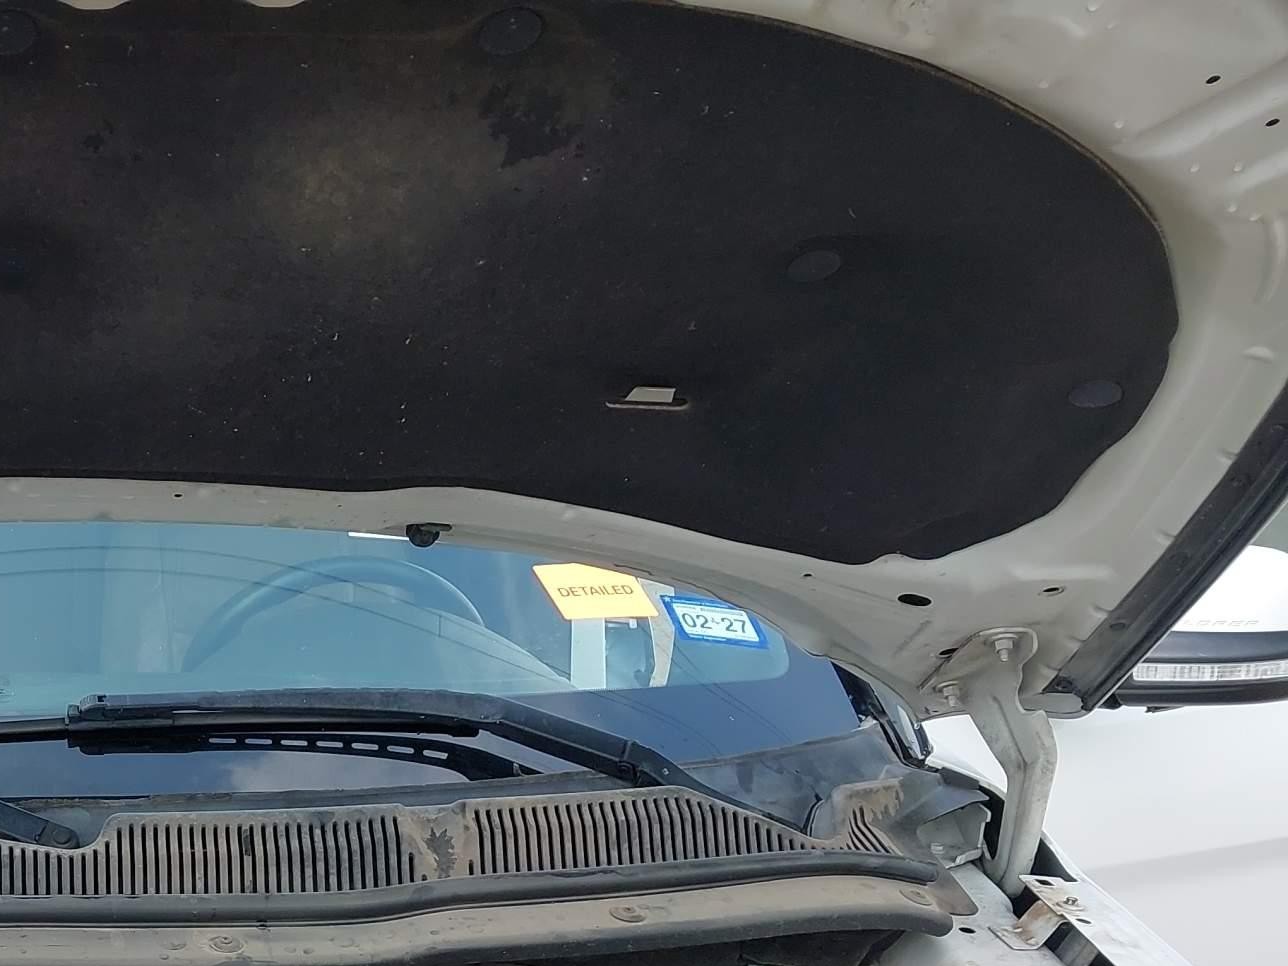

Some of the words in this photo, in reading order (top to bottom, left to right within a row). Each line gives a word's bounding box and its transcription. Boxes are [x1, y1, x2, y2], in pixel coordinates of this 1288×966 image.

[556, 583, 634, 598] DETAILED
[681, 612, 713, 630] 02
[720, 617, 747, 634] 27
